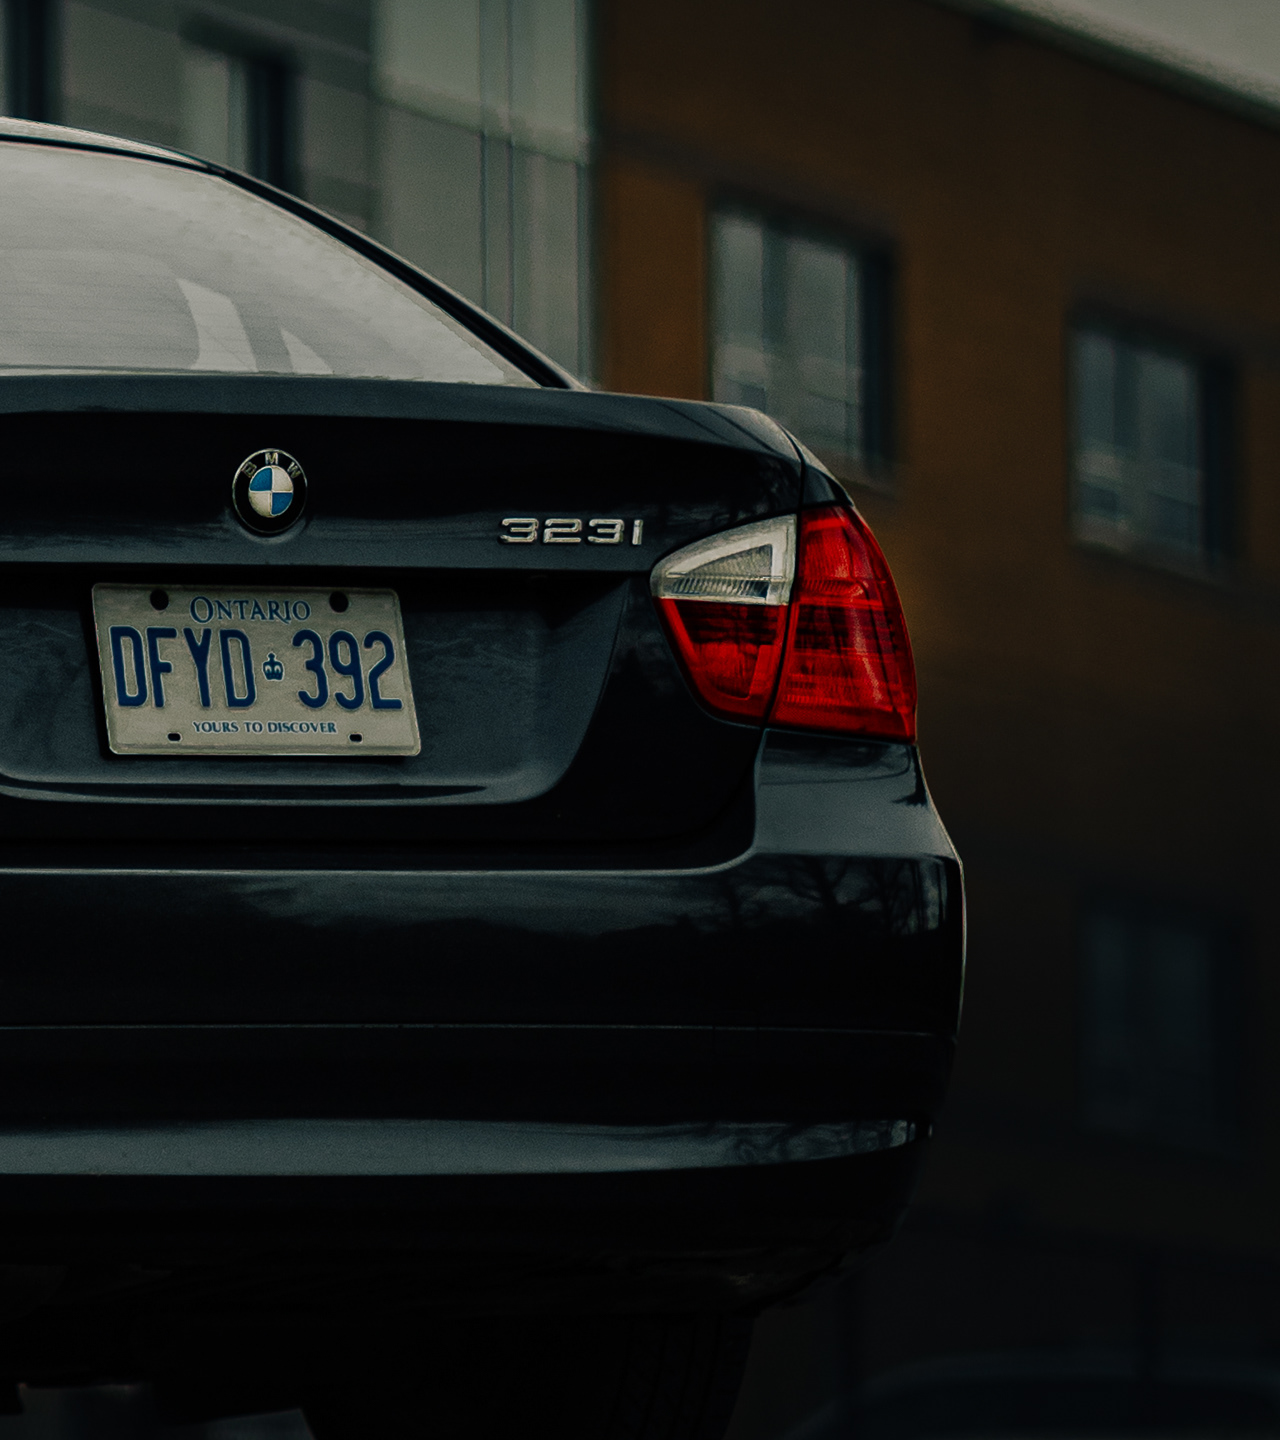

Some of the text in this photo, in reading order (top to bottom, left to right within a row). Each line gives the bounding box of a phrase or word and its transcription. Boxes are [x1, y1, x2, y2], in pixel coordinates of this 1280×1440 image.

[241, 452, 301, 478] BMW
[190, 596, 311, 623] ONTARIO
[110, 626, 402, 709] DFYD 392
[192, 721, 337, 734] YOURS TO DISCOVER
